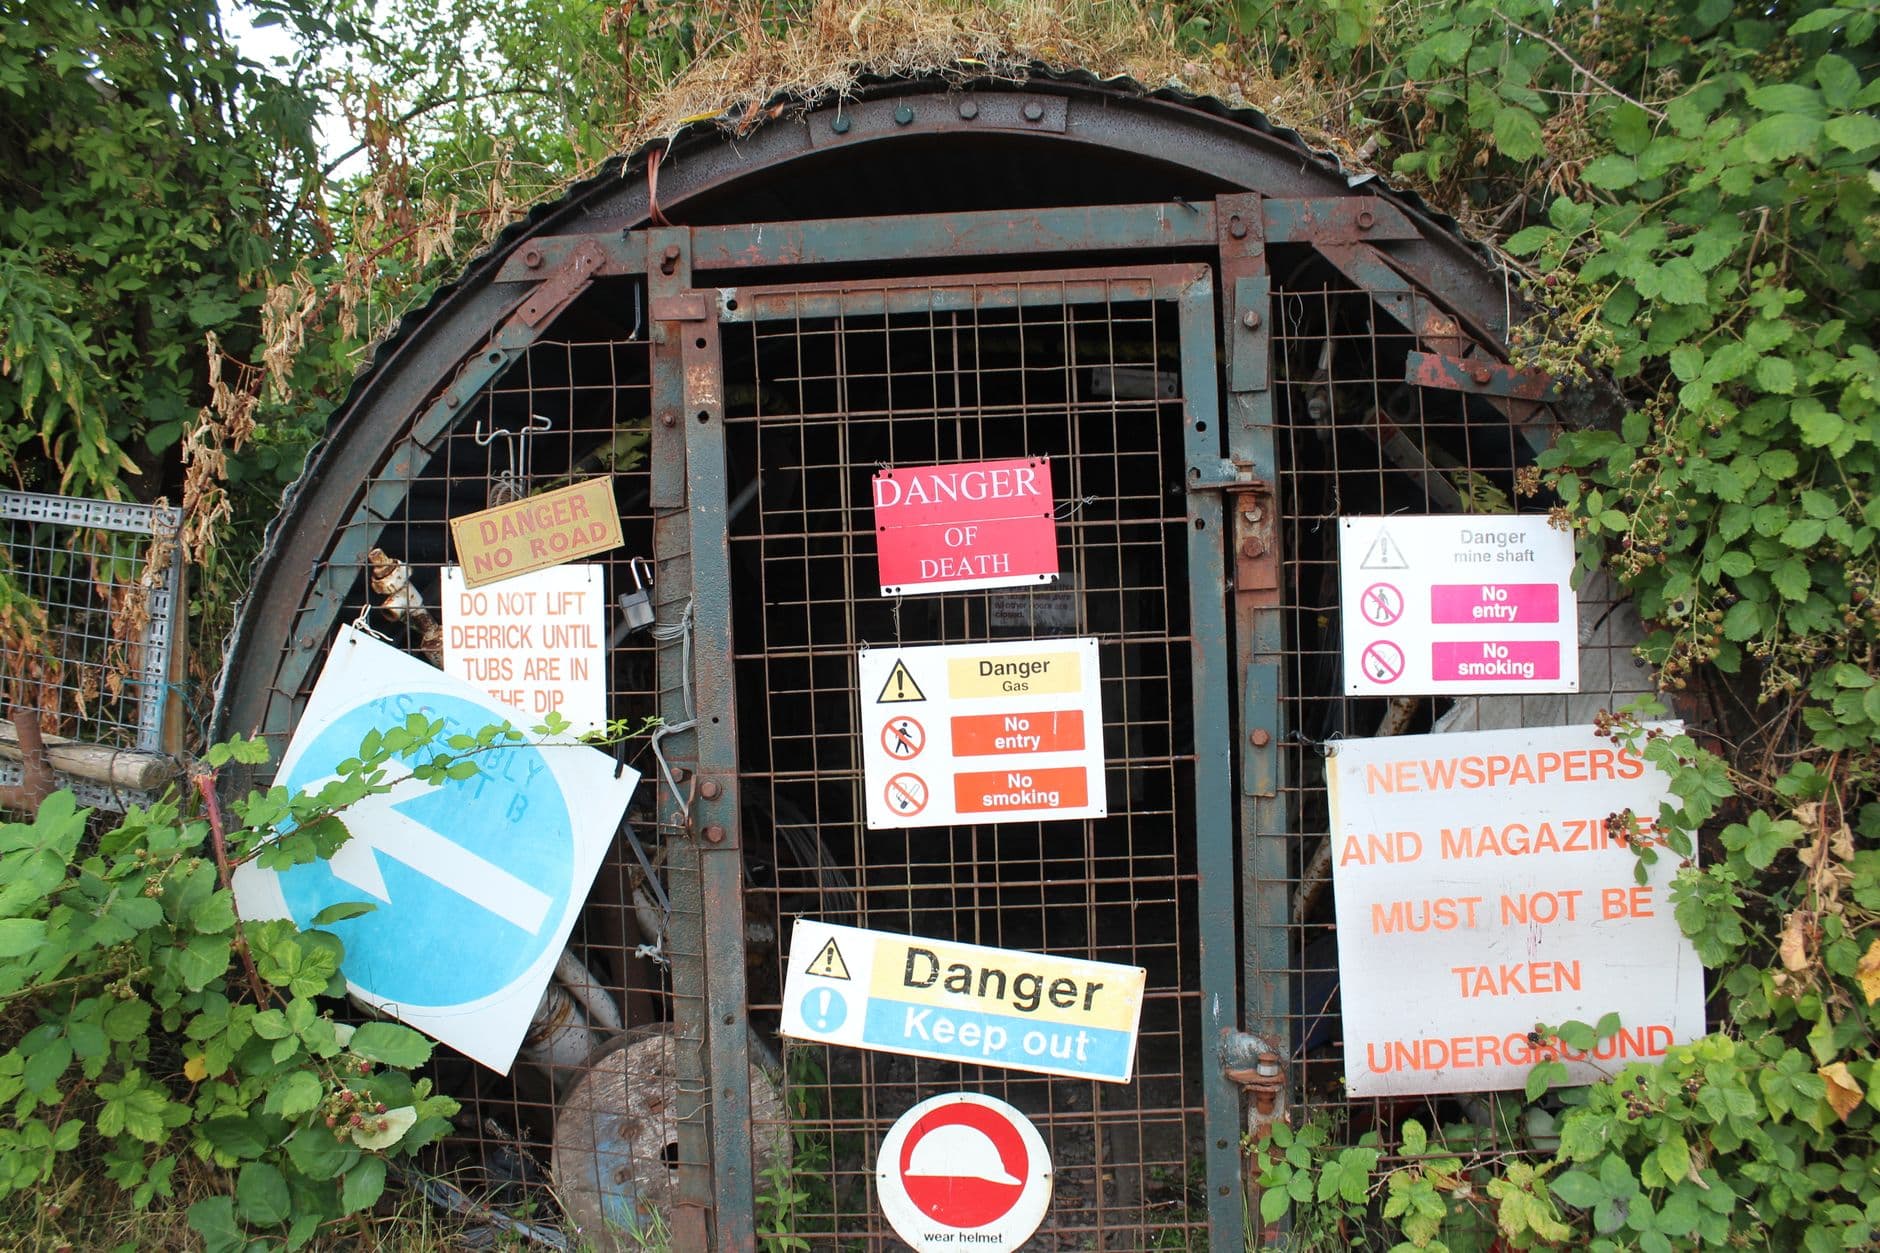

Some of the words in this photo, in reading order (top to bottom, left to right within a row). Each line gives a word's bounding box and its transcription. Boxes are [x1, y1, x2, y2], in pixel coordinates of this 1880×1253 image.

[873, 467, 1040, 508] DANGER
[479, 494, 590, 545] DANGER
[473, 547, 513, 574] NO
[530, 521, 607, 559] ROAD
[944, 526, 978, 547] OF
[1460, 530, 1527, 547] Danger
[920, 553, 1010, 579] DEATH
[1454, 550, 1491, 563] mine
[1496, 549, 1534, 562] shaft
[460, 592, 488, 616] DO
[497, 592, 537, 616] NOT
[547, 592, 586, 615] LIFT
[1482, 586, 1507, 601] No
[1472, 603, 1518, 621] entry
[451, 624, 533, 649] DERRICK
[543, 624, 598, 648] UNTIL
[1483, 643, 1508, 658] No
[462, 657, 513, 681] TUBS
[523, 657, 561, 681] ARE
[570, 657, 588, 681] IN
[978, 659, 1051, 679] Danger
[1458, 661, 1535, 678] smoking
[1002, 680, 1029, 692] Gas
[534, 689, 564, 713] DIP
[1004, 716, 1030, 732] No
[369, 694, 544, 787] ASEBLY
[994, 733, 1041, 751] entry
[1007, 773, 1033, 788] No
[1366, 748, 1644, 795] NEWSPAPERS
[982, 789, 1060, 807] smoking
[1340, 831, 1423, 867] AND
[1371, 897, 1482, 935] MUST
[1500, 890, 1583, 925] NOT
[1601, 886, 1654, 920] BE
[903, 946, 1104, 1012] Danger
[1451, 960, 1582, 998] TAKEN
[903, 1007, 1008, 1056] Keep
[1022, 1028, 1090, 1062] out
[924, 1233, 955, 1243] wear
[959, 1232, 1002, 1243] helmet
